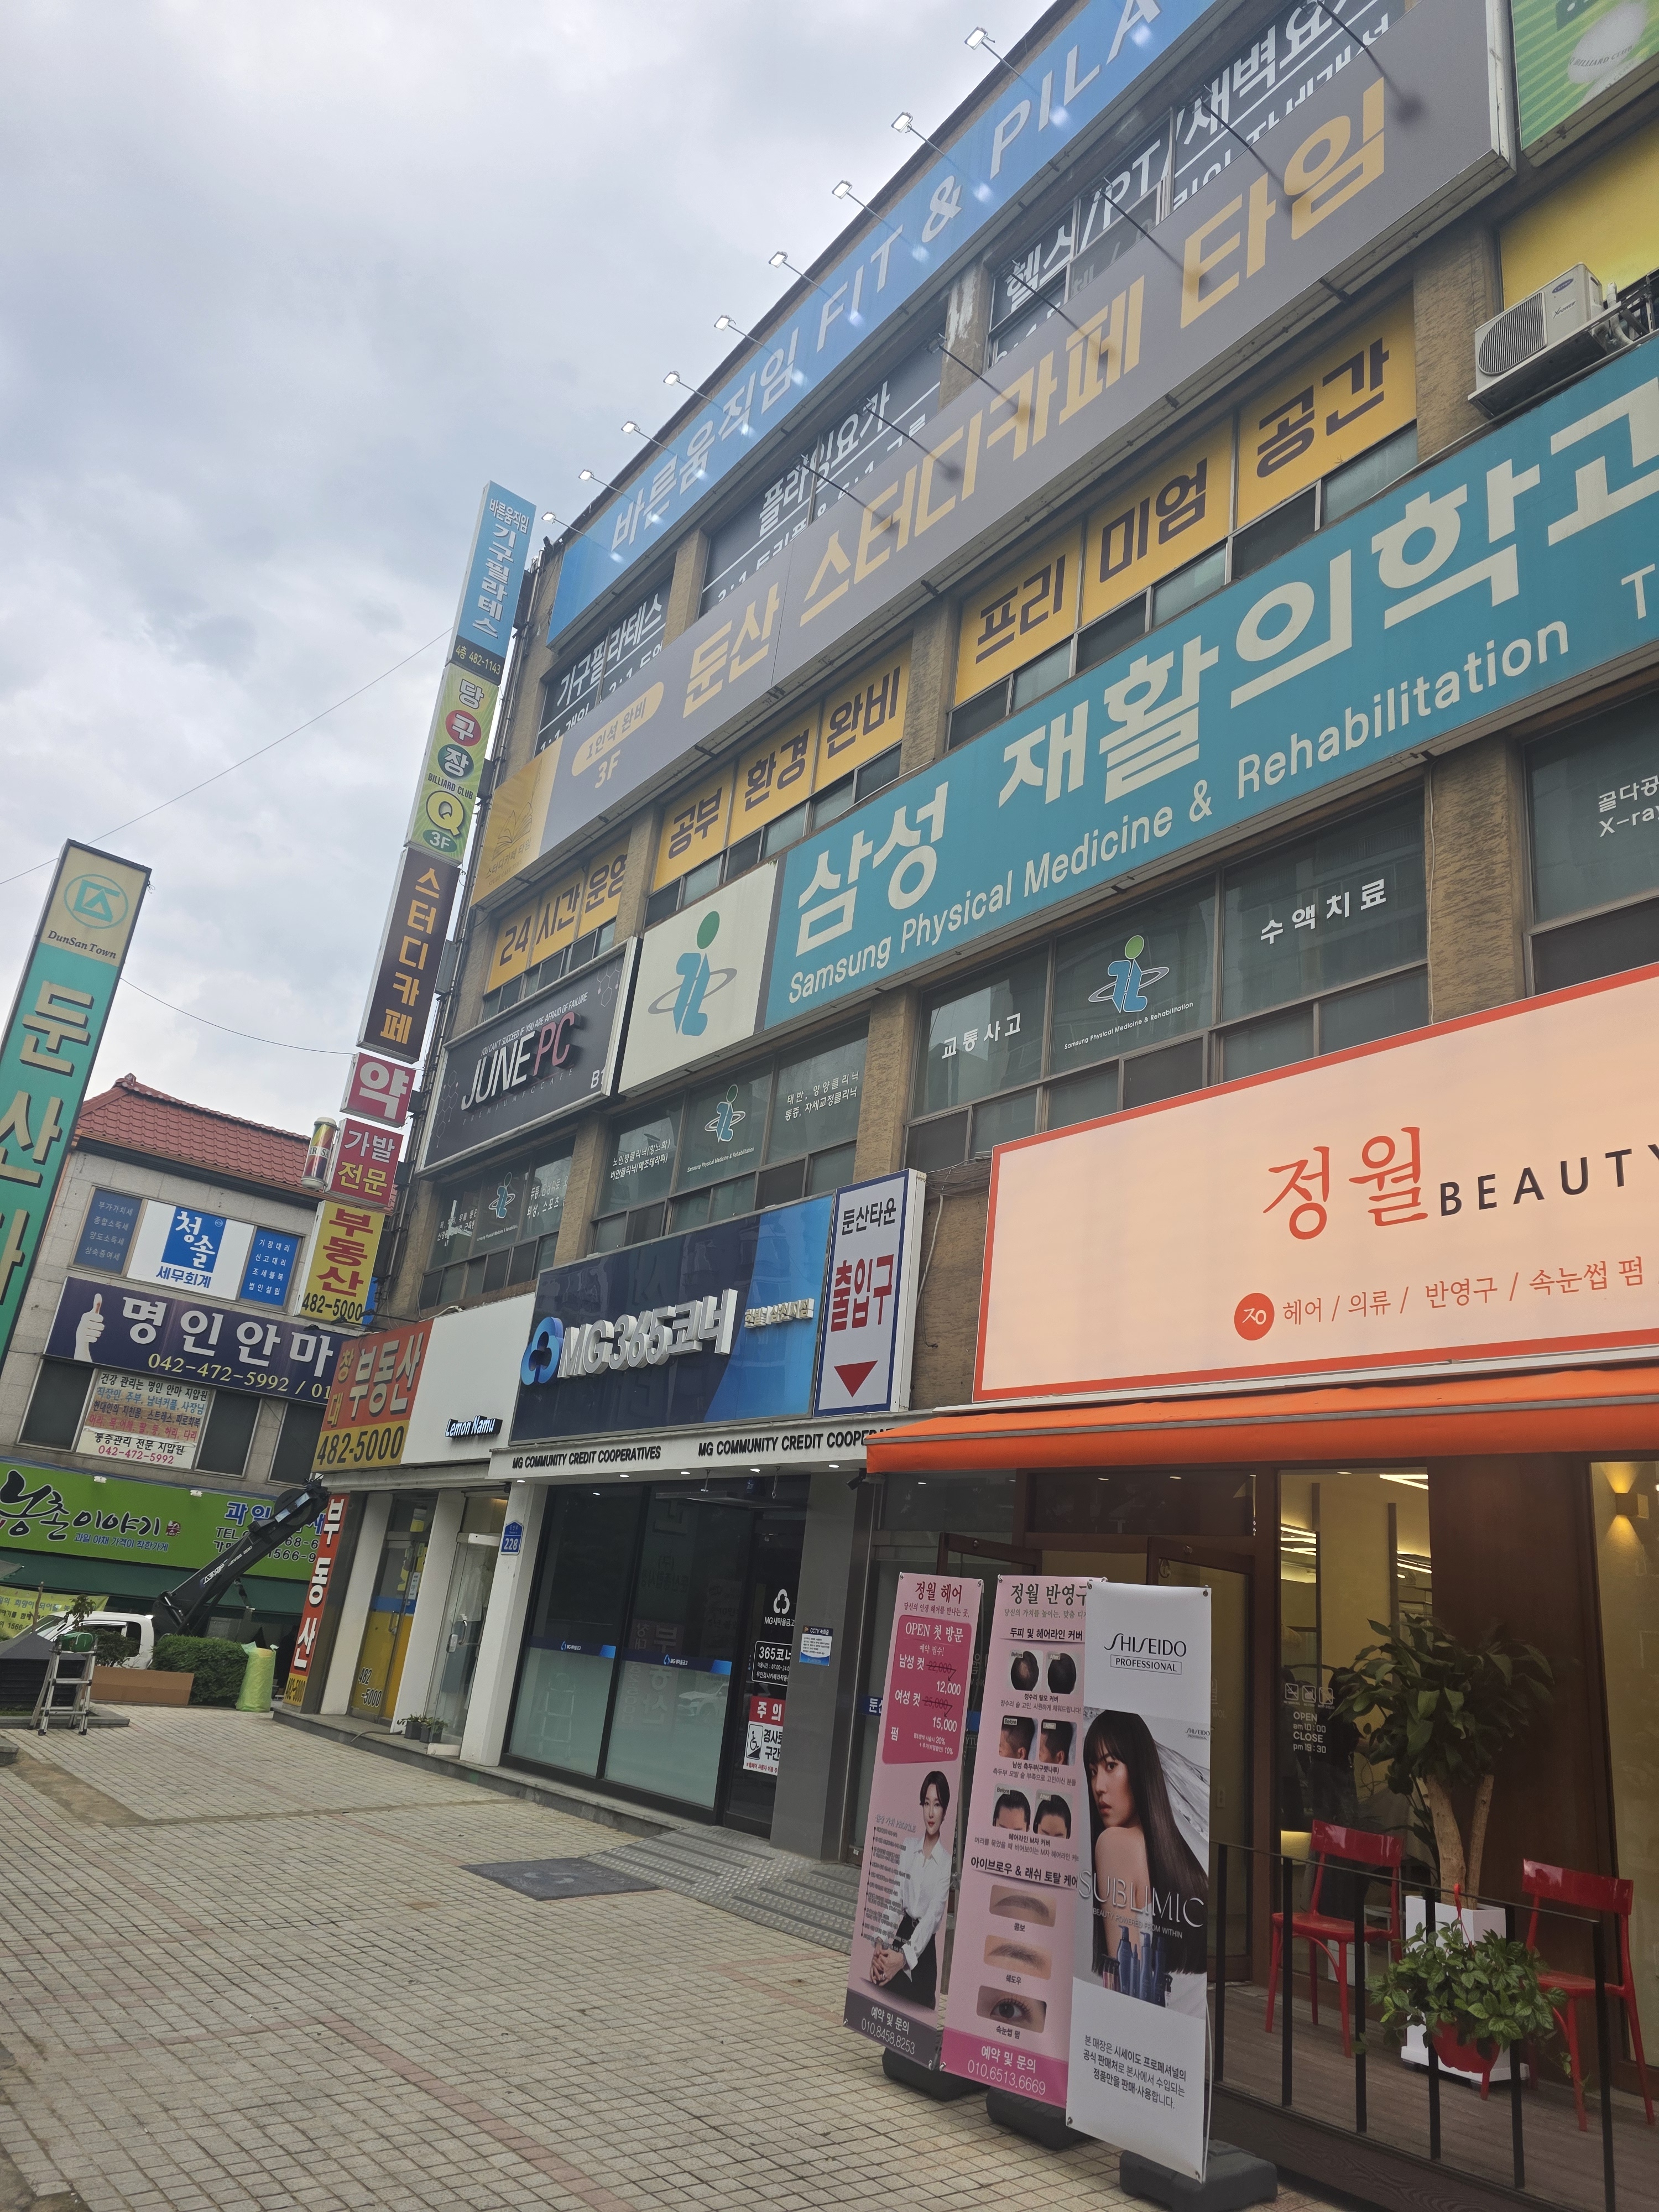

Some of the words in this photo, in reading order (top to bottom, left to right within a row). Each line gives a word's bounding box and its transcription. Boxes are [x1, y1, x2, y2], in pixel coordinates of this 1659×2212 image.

[611, 326, 800, 552] 바른움직임
[816, 225, 902, 353] FIT
[922, 175, 962, 243] &
[682, 582, 779, 718] 둔산
[796, 275, 1145, 630] 스터디카페
[1181, 76, 1384, 328] 타임
[1256, 337, 1389, 478] 공간
[759, 380, 890, 537] 플라잉요가
[489, 498, 529, 535] 바른움직임
[472, 523, 516, 639] 기구필라테스
[456, 645, 467, 660] 4층
[468, 652, 501, 676] 482-1143
[557, 593, 662, 706] 기구필라테스
[444, 679, 484, 776] 당구장
[586, 721, 618, 760] 1인석
[622, 696, 646, 734] 완비
[595, 750, 621, 789] 3F
[668, 787, 722, 859] 공부
[745, 728, 810, 812] 환경
[827, 665, 901, 759] 완비
[427, 773, 456, 792] BILLIARD
[457, 786, 474, 800] CLUB
[426, 790, 465, 837] Q
[789, 936, 891, 1004] Samsung
[900, 870, 1013, 953] Physical
[1023, 806, 1174, 899] Medicine
[1189, 779, 1213, 822] &
[1237, 620, 1569, 800] Rehabilitation
[429, 831, 451, 849] 3F
[796, 781, 949, 957] 삼성
[499, 916, 532, 967] 24
[536, 883, 581, 946] 시간
[1260, 878, 1386, 945] 수액치료
[47, 930, 88, 952] DunSan
[88, 943, 116, 960] Town
[380, 868, 440, 1045] 스터디카페
[942, 1013, 1021, 1060] 교통사고
[1064, 1037, 1088, 1050] Samsung
[1090, 1027, 1114, 1042] Physical
[1115, 1018, 1142, 1033] Medicine
[1150, 1001, 1194, 1021] Rehabilitation
[359, 1062, 410, 1119] 약
[813, 1070, 859, 1097] 영양클리닉
[805, 1086, 857, 1114] 자세교정클리닉
[344, 1129, 395, 1164] 가발
[338, 1161, 388, 1197] 전문
[1263, 1126, 1429, 1241] 정월
[98, 1201, 134, 1217] 부가가치세
[842, 1197, 896, 1235] 둔산타운
[90, 1230, 125, 1246] 양도소득세
[93, 1216, 128, 1232] 종합소득세
[85, 1246, 120, 1262] 상속증여세
[175, 1211, 215, 1269] 청솔
[258, 1239, 290, 1253] 기장대리
[317, 1208, 374, 1297] 부동산
[252, 1267, 284, 1281] 조세불복
[255, 1253, 286, 1267] 신고대리
[155, 1266, 212, 1289] 세무회계
[249, 1282, 280, 1296] 법인설립
[1283, 1297, 1322, 1325] 헤어
[1348, 1291, 1391, 1318] 의류
[1426, 1277, 1498, 1309] 반영구
[1528, 1260, 1608, 1296] 속눈썹
[1619, 1256, 1644, 1287] 펌
[302, 1292, 363, 1322] 482-5000
[831, 1254, 894, 1332] 출입구
[122, 1296, 333, 1378] 명인안마
[148, 1353, 290, 1392] 042-472-5992
[349, 1332, 424, 1417] 부동산
[101, 1373, 117, 1385] 건강
[120, 1376, 144, 1390] 관리는
[148, 1381, 163, 1394] 명인
[166, 1384, 182, 1397] 안마
[185, 1387, 208, 1401] 지압원
[181, 1401, 205, 1415] 사장님
[445, 1419, 472, 1437] Lemon
[471, 1416, 495, 1434] Namu
[95, 1432, 132, 1447] 통증관리
[136, 1439, 153, 1451] 전문
[158, 1442, 185, 1455] 지압원
[98, 1445, 174, 1464] 042-472-5992
[316, 1426, 404, 1465] 482-5000
[512, 1457, 523, 1469] MG
[524, 1453, 568, 1469] COMMUNITY
[568, 1450, 597, 1465] CREDIT
[598, 1445, 661, 1463] COOPERATIVES
[698, 1442, 713, 1456] MG
[716, 1437, 778, 1453] COMMUNITY
[781, 1433, 823, 1451] CREDIT
[74, 1533, 90, 1542] 과일
[93, 1535, 109, 1546] 야채
[111, 1538, 134, 1548] 가격이
[136, 1540, 169, 1553] 착한가게
[504, 1538, 518, 1550] 228
[294, 1499, 345, 1668] 부동산
[916, 1581, 936, 1601] 정월
[941, 1584, 962, 1605] 헤어
[1010, 1583, 1039, 1605] 정월
[1004, 1608, 1021, 1618] 당신의
[1022, 1609, 1040, 1618] 가치를
[905, 1622, 930, 1638] OPEN
[933, 1625, 942, 1641] 첫
[946, 1626, 963, 1644] 방문
[1010, 1628, 1024, 1638] 두피
[1027, 1629, 1034, 1639] 및
[1036, 1628, 1066, 1640] 헤어라인
[1068, 1630, 1083, 1641] 커버
[1104, 1632, 1187, 1657] SHISEIDO
[899, 1653, 914, 1670] 남성
[916, 1656, 925, 1671] 컷
[919, 1644, 931, 1654] 예약
[359, 1667, 372, 1685] 482
[1115, 1658, 1177, 1672] PROFESSIONAL
[895, 1689, 910, 1705] 여성
[912, 1692, 921, 1707] 컷
[936, 1680, 961, 1696] 12,000
[932, 1716, 957, 1732] 15,000
[1293, 1711, 1317, 1722] OPEN
[890, 1726, 899, 1741] 펌
[1185, 1728, 1211, 1737] SHISEIDO
[1293, 1731, 1323, 1743] CLOSE
[1009, 1833, 1029, 1843] 헤어라인
[971, 1856, 1012, 1875] 아이브로우
[1025, 1867, 1042, 1881] 래쉬
[1044, 1871, 1061, 1885] 토탈
[1078, 1868, 1206, 1929] SUBLIMIC
[1014, 1923, 1025, 1932] 콤보
[1093, 1907, 1114, 1921] BEAUTY
[1115, 1913, 1143, 1929] POWERED
[1161, 1924, 1183, 1939] WITHIN
[870, 2006, 885, 2024] 예약
[886, 2012, 895, 2028] 및
[895, 2016, 910, 2034] 문의
[996, 2026, 1013, 2037] 속눈썹
[861, 2018, 915, 2056] 010.8458.8253
[981, 2046, 1001, 2063] 예약
[1004, 2051, 1013, 2067] 및
[1017, 2055, 1036, 2074] 문의
[1084, 2034, 1092, 2047] 본
[1093, 2038, 1113, 2055] 매장은
[1114, 2046, 1142, 2065] 시세이도
[1144, 2055, 1187, 2083] 프로페셔널의
[968, 2059, 1046, 2095] 010.6513.6669
[1083, 2049, 1097, 2064] 공식
[1098, 2053, 1125, 2075] 판매처로
[1126, 2063, 1155, 2085] 본사에서
[1156, 2074, 1185, 2098] 수입되는
[1093, 2068, 1120, 2089] 정품만을
